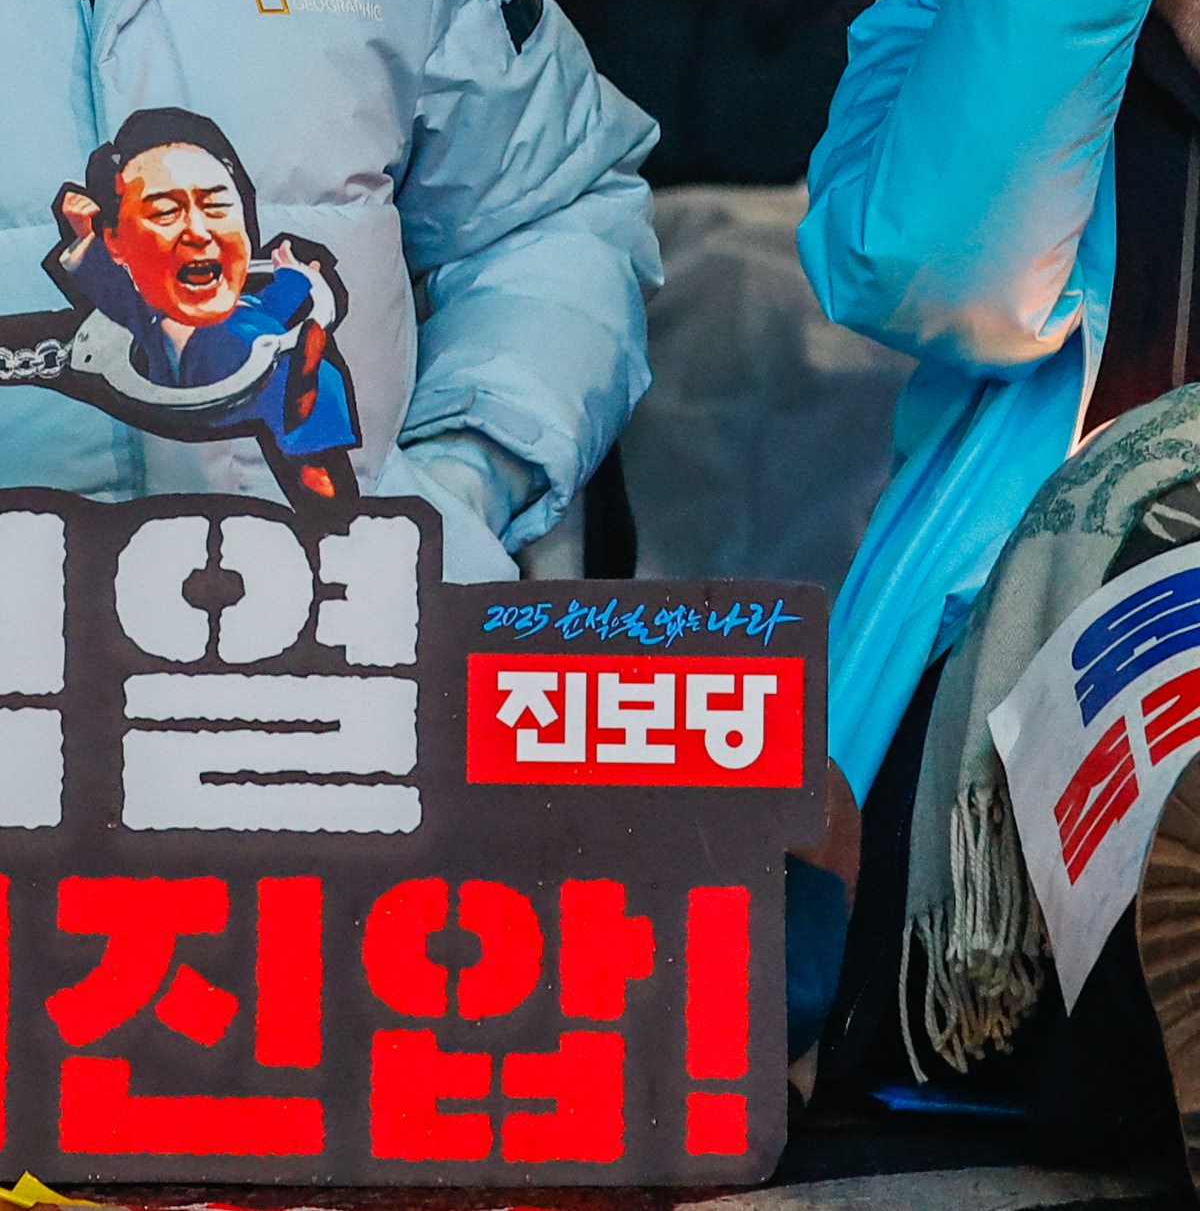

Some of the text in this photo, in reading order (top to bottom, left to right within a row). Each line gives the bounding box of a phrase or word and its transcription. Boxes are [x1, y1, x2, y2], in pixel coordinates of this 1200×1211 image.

[483, 603, 553, 640] 2025
[554, 598, 665, 647] 윤석열
[707, 598, 805, 648] 나라
[496, 670, 778, 770] 진보당
